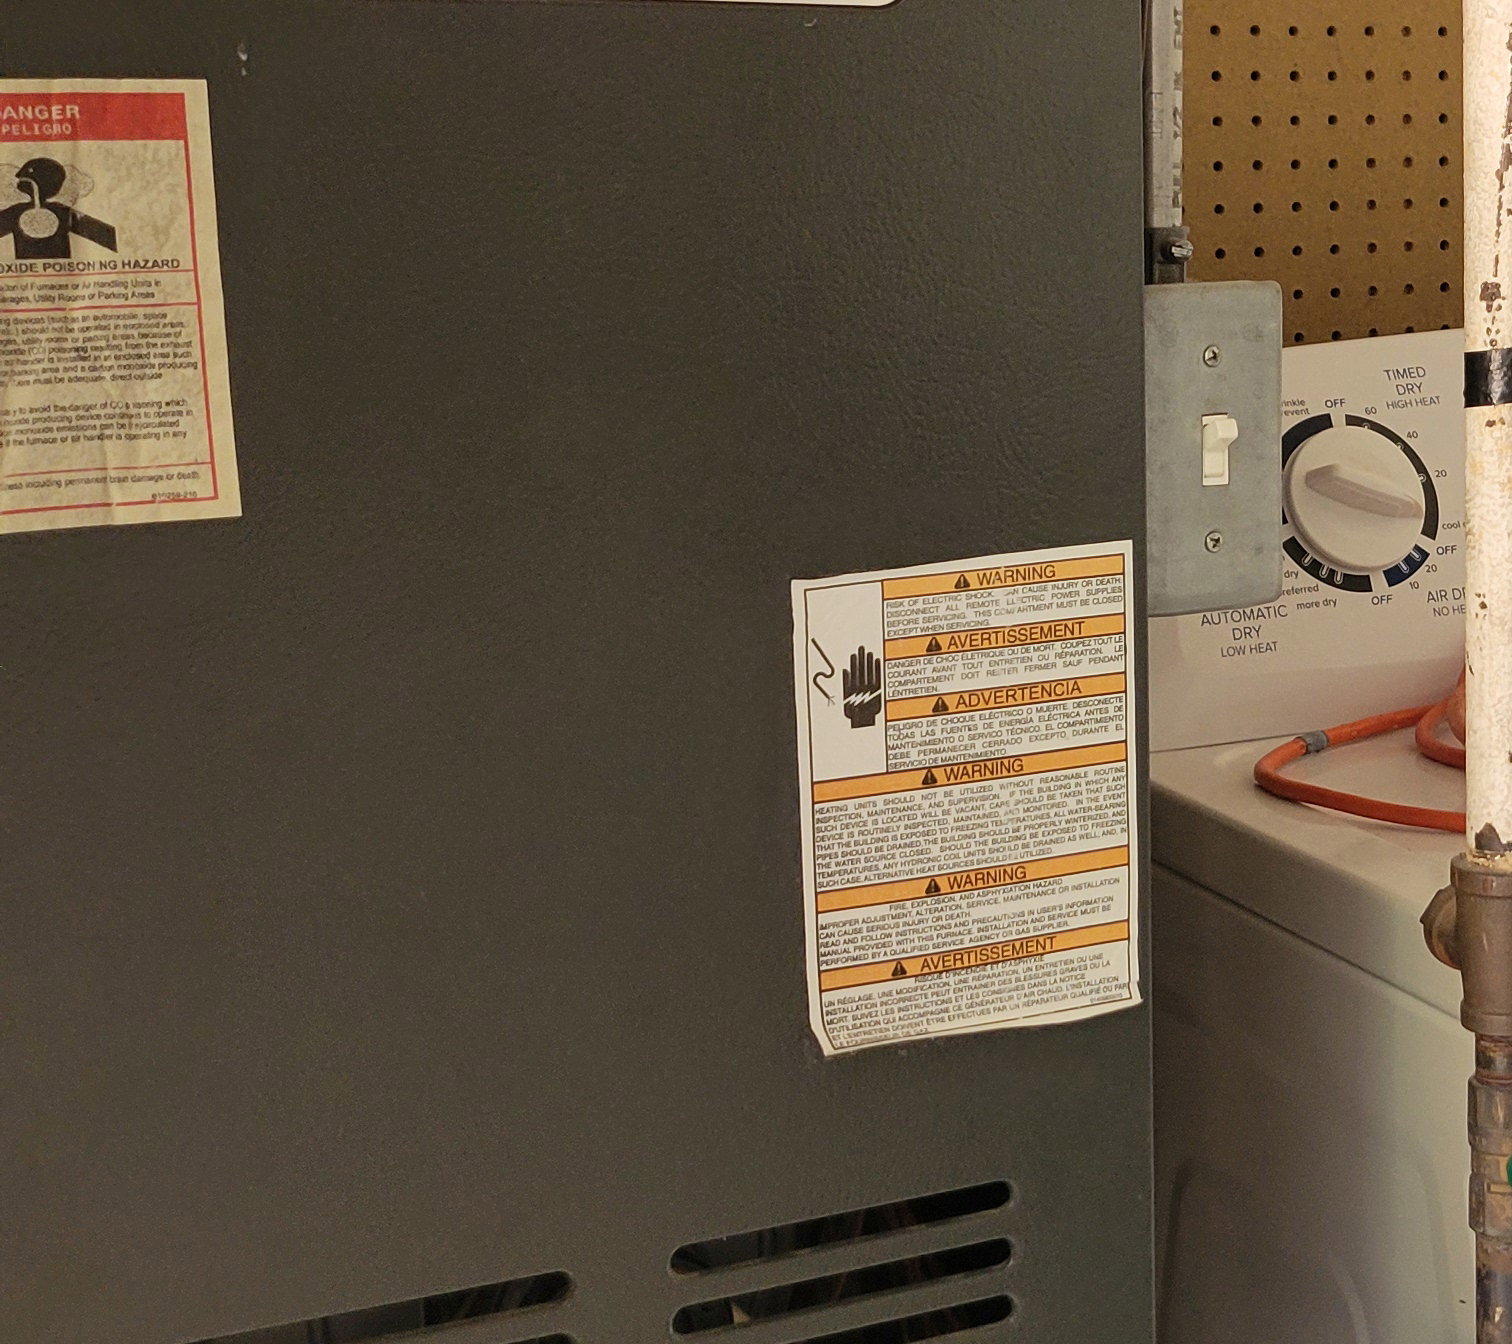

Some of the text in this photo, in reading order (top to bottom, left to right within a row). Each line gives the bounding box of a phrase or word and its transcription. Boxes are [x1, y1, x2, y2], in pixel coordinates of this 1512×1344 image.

[0, 104, 80, 120] ANGER
[121, 258, 181, 270] HAZARD
[1383, 366, 1427, 383] TIMED
[1395, 382, 1423, 396] DRY
[1281, 399, 1306, 407] rinkle
[1324, 398, 1346, 409] OFF
[1386, 395, 1441, 410] HIGH HEAT
[1364, 406, 1378, 416] 60
[1406, 430, 1419, 440] 40
[1434, 469, 1448, 479] 20
[1442, 521, 1461, 530] cool
[1436, 544, 1457, 556] OFF
[977, 564, 1056, 586] WARNING
[1283, 570, 1299, 579] dry
[1425, 564, 1438, 573] 20
[1050, 581, 1079, 590] INJURY
[1282, 583, 1320, 596] referred
[1409, 580, 1420, 590] 10
[1050, 590, 1080, 600] POWER
[1055, 600, 1077, 608] MUST
[1079, 598, 1090, 606] BE
[1091, 594, 1124, 604] CLOSED
[1371, 594, 1394, 606] OFF
[1426, 588, 1449, 603] AIR
[1296, 597, 1338, 610] more dry
[1200, 604, 1289, 627] AUTOMATIC
[1433, 605, 1450, 617] NO
[886, 626, 918, 637] EXCEPT
[918, 623, 945, 633] WHEN
[947, 621, 1086, 650] AVERTISSEMENT
[1231, 625, 1263, 641] DRY
[886, 659, 922, 669] DANGER
[922, 657, 934, 665] DE
[1092, 637, 1113, 645] TOUT
[1113, 635, 1123, 643] LE
[1220, 641, 1278, 658] LOW HEAT
[955, 681, 1082, 709] ADVERTENCIA
[944, 759, 1024, 782] WARNING
[1111, 773, 1126, 782] ANY
[947, 866, 1027, 891] WARNING
[920, 936, 1057, 973] AVERTISSEMENT
